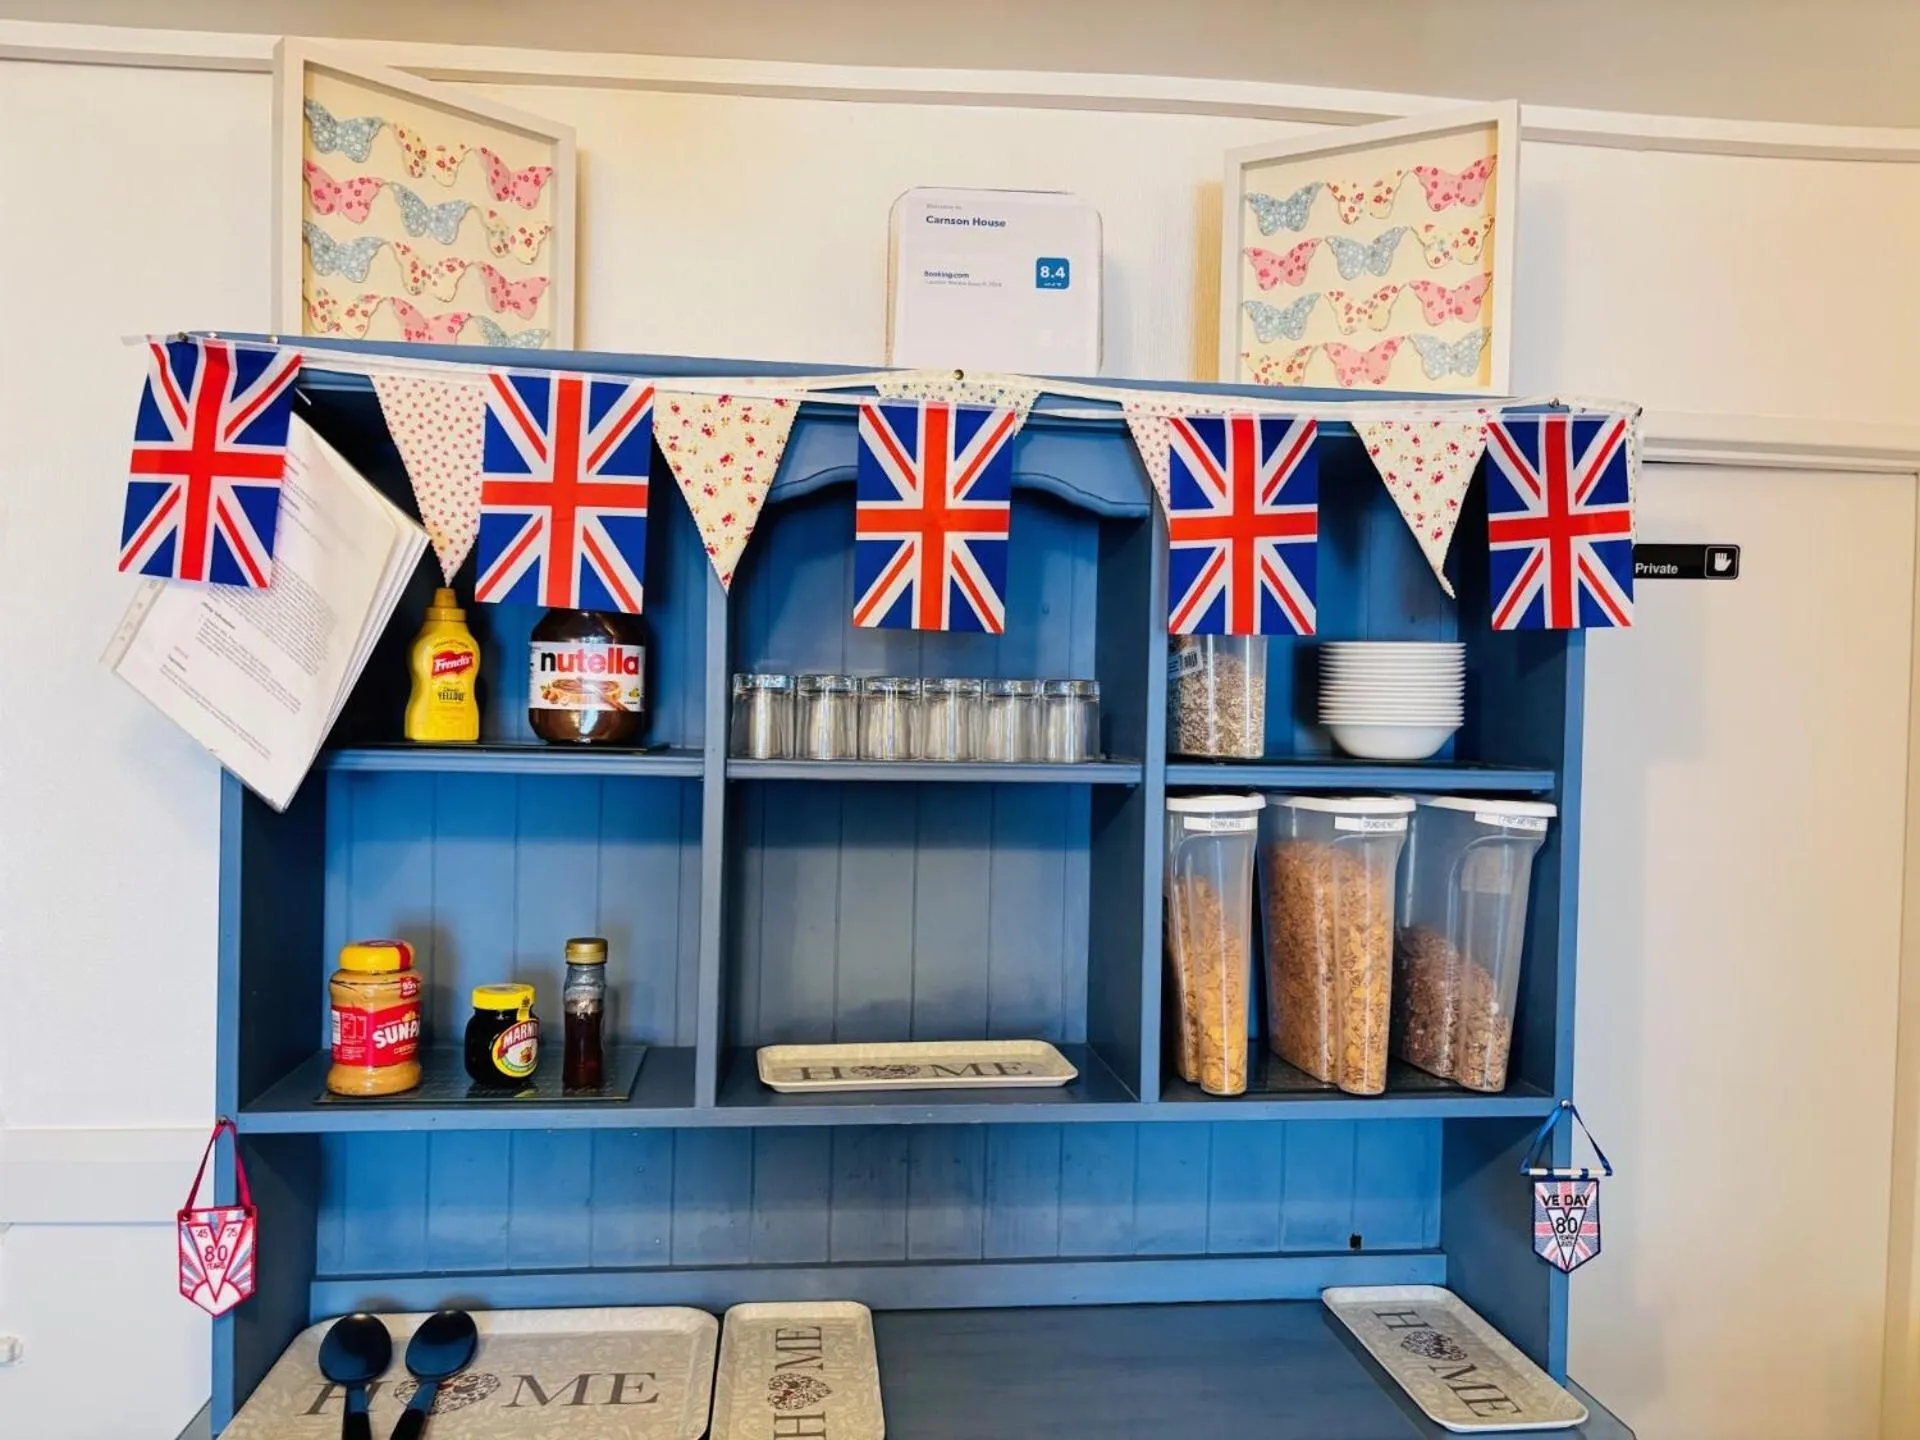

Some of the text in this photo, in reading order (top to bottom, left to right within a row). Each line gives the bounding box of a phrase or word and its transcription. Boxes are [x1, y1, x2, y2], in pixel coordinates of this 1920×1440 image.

[925, 215, 1007, 228] Carnson House
[1039, 265, 1066, 280] 8.4
[1635, 562, 1679, 575] Private
[540, 647, 640, 675] nutella
[1541, 1194, 1591, 1207] VE DAY
[1555, 1216, 1578, 1234] 80
[204, 1244, 228, 1262] 80
